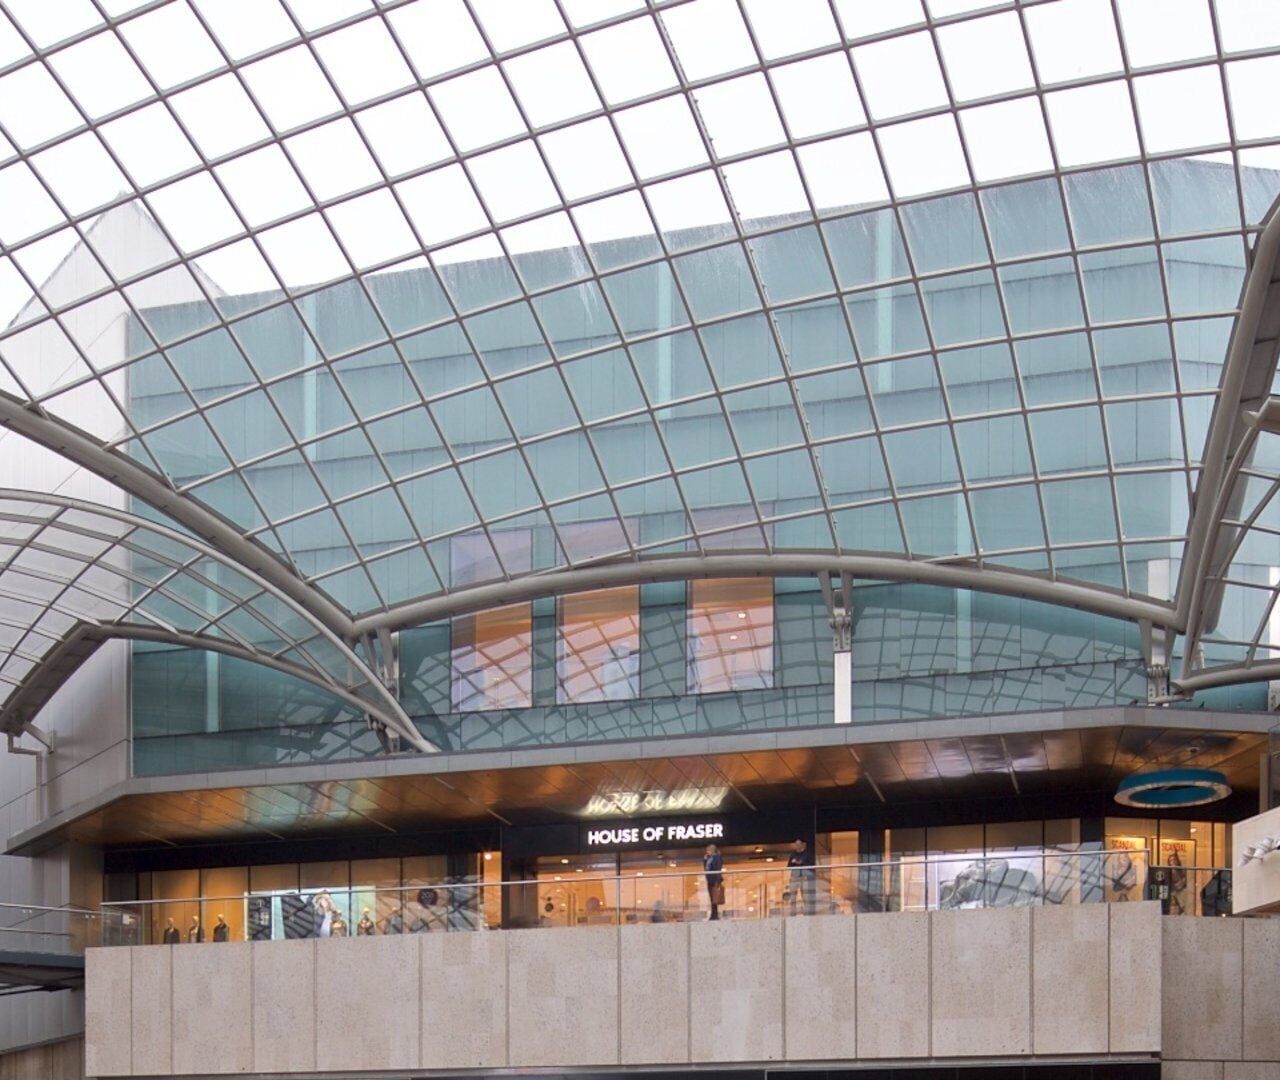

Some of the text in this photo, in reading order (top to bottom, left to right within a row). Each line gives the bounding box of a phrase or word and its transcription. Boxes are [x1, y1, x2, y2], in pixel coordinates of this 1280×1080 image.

[588, 824, 723, 845] HOUSE OF FRASER
